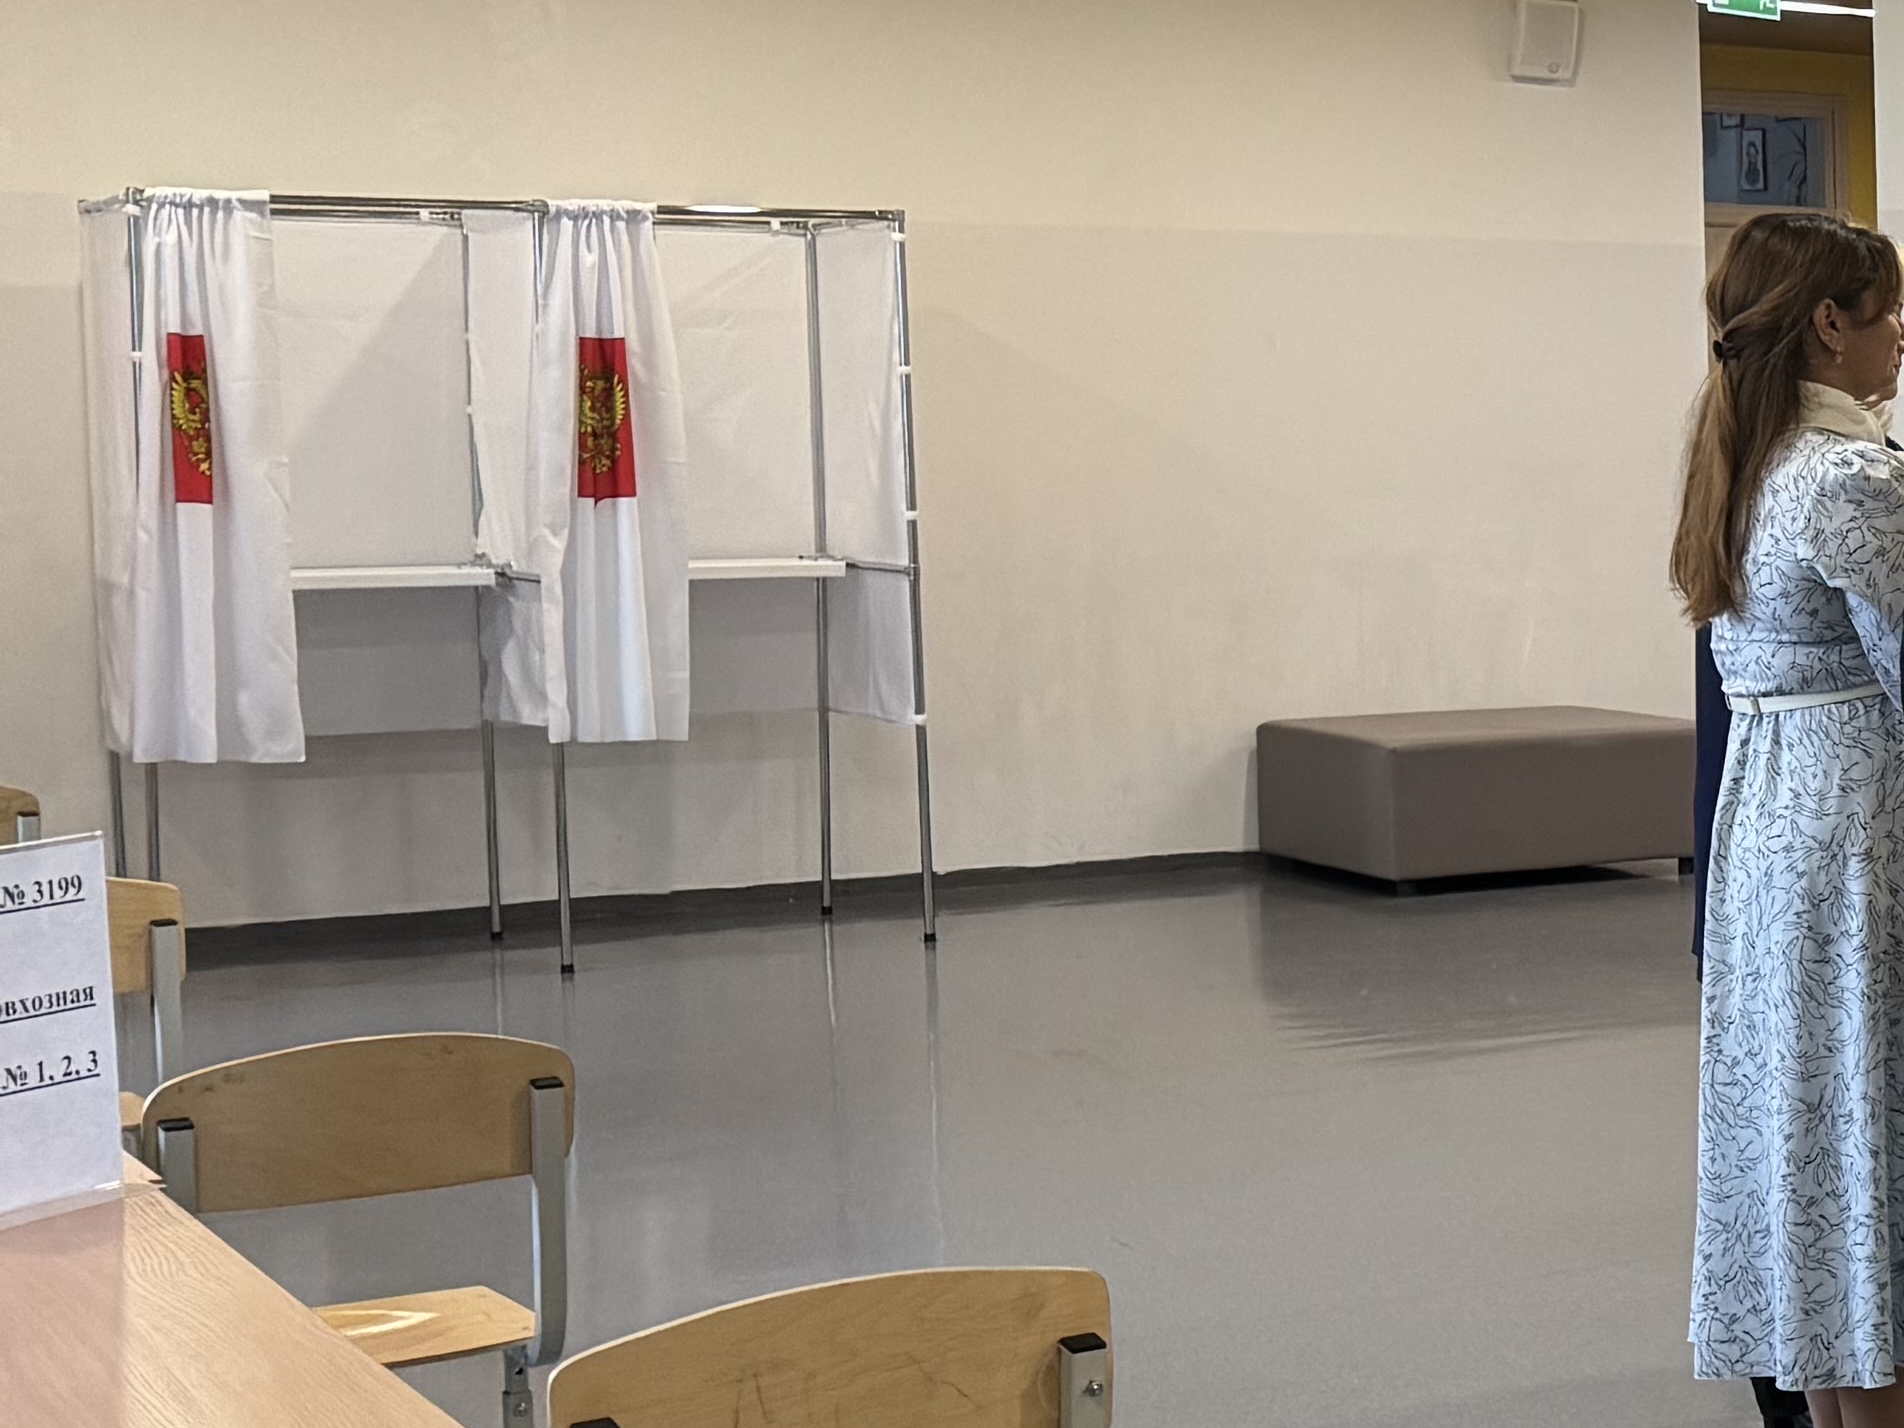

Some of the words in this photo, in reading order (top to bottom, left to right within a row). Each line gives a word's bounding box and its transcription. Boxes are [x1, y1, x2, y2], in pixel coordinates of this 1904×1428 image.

[32, 875, 82, 904] 3199
[0, 986, 95, 1018] вхозная
[1, 1065, 28, 1091] №
[87, 1050, 99, 1073] 3
